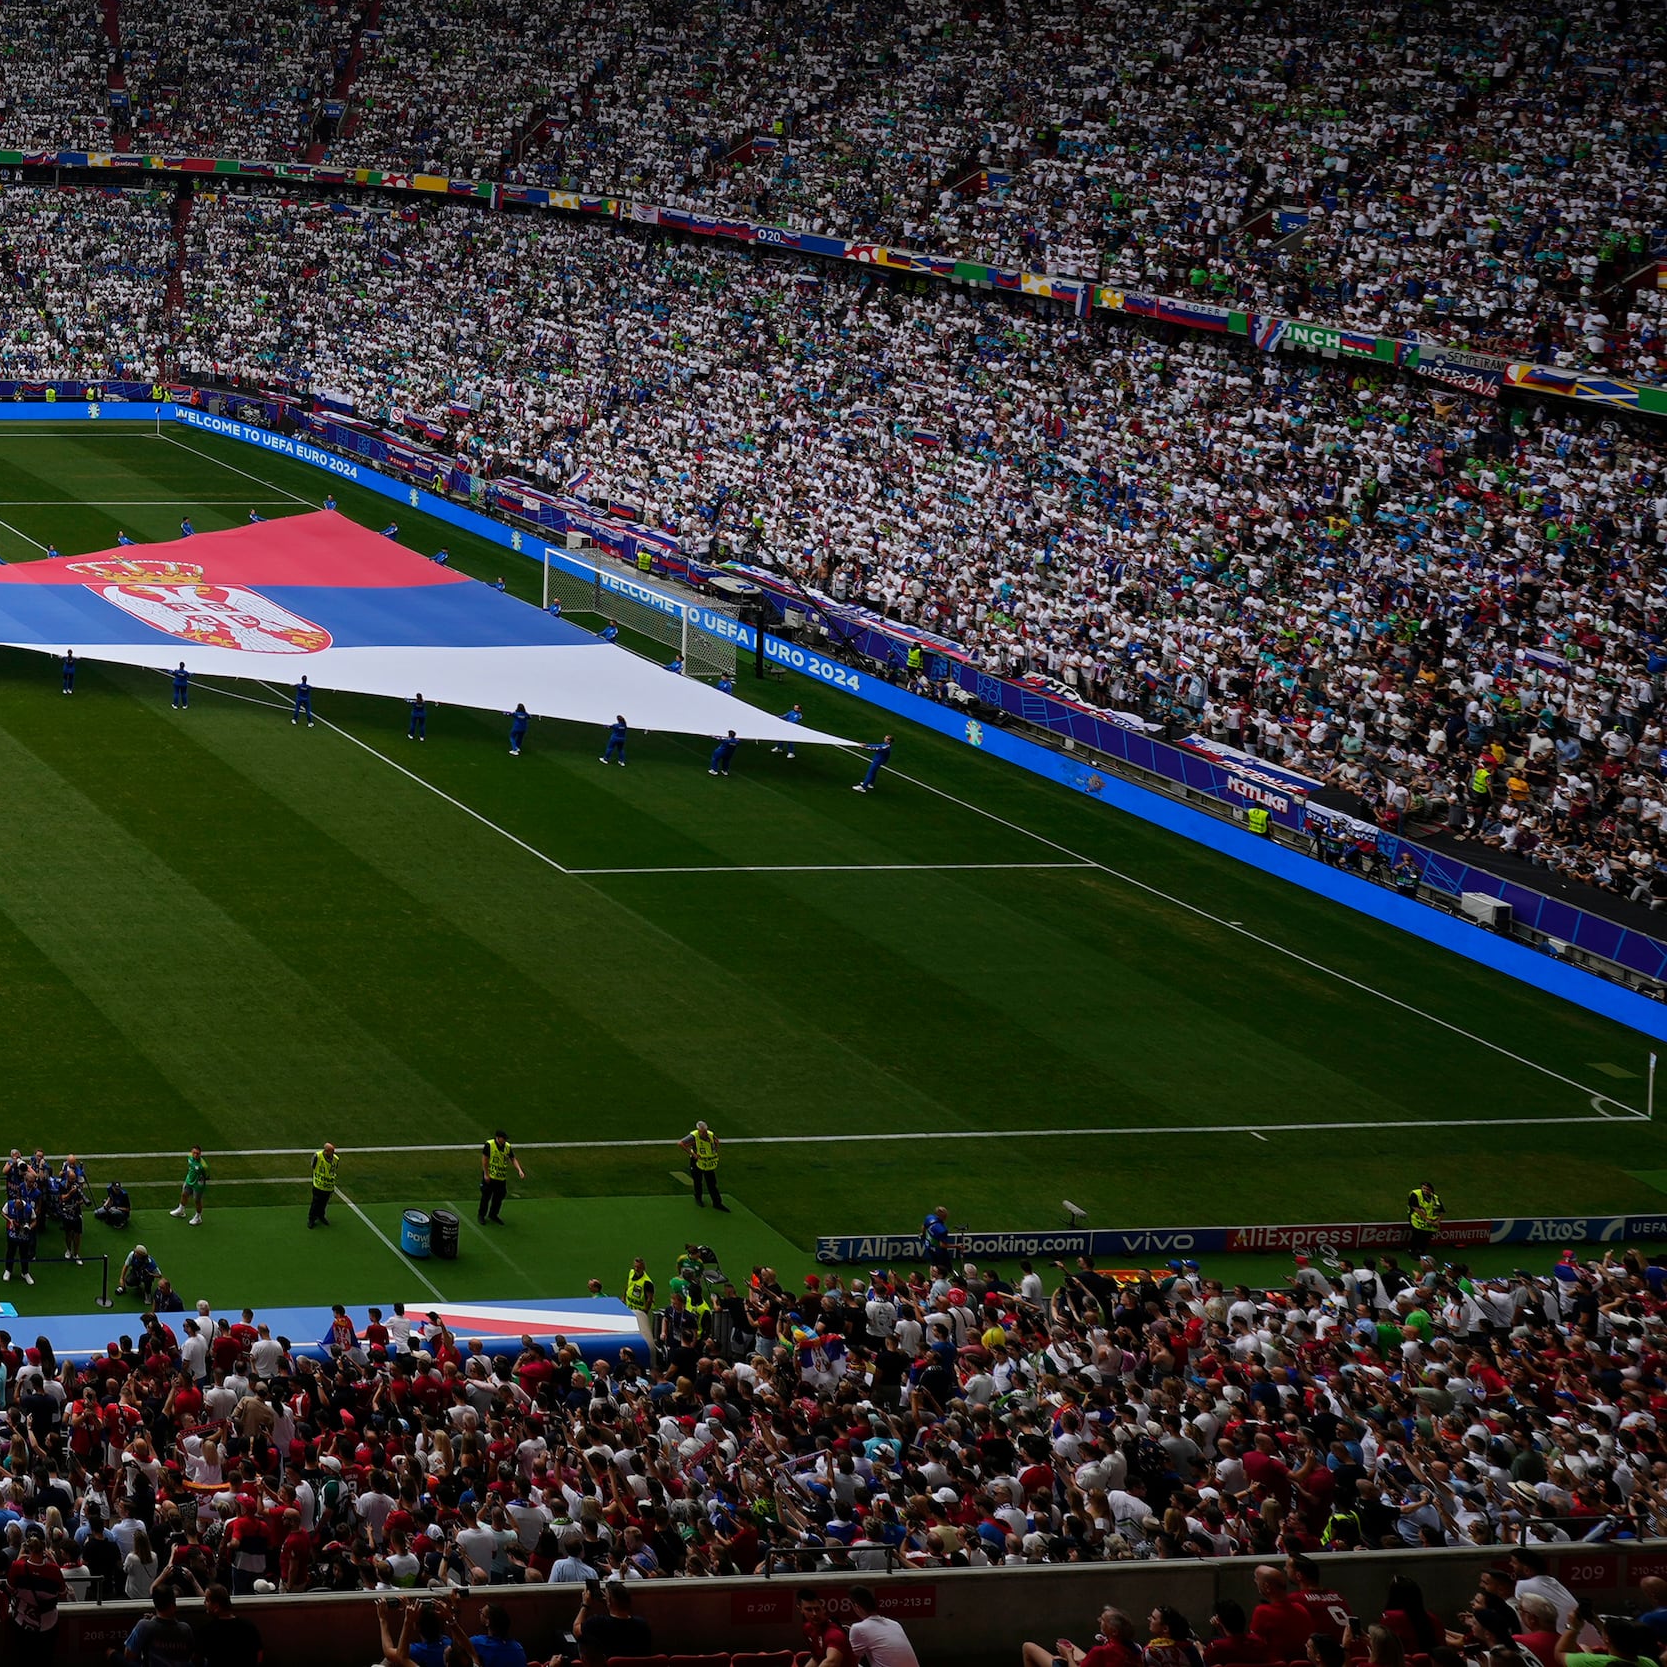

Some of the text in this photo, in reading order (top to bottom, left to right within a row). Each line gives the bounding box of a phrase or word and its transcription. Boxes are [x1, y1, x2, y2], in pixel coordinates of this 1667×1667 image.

[1185, 303, 1221, 315] KOPER
[175, 406, 359, 478] WELCOME TO UEFA EURO 2024
[807, 657, 860, 692] 2024
[962, 1233, 1086, 1259] Booking.com
[1233, 1225, 1358, 1248] AliExpress
[1570, 1564, 1605, 1581] 209
[757, 1602, 777, 1613] 207
[879, 1596, 922, 1608] 209-213
